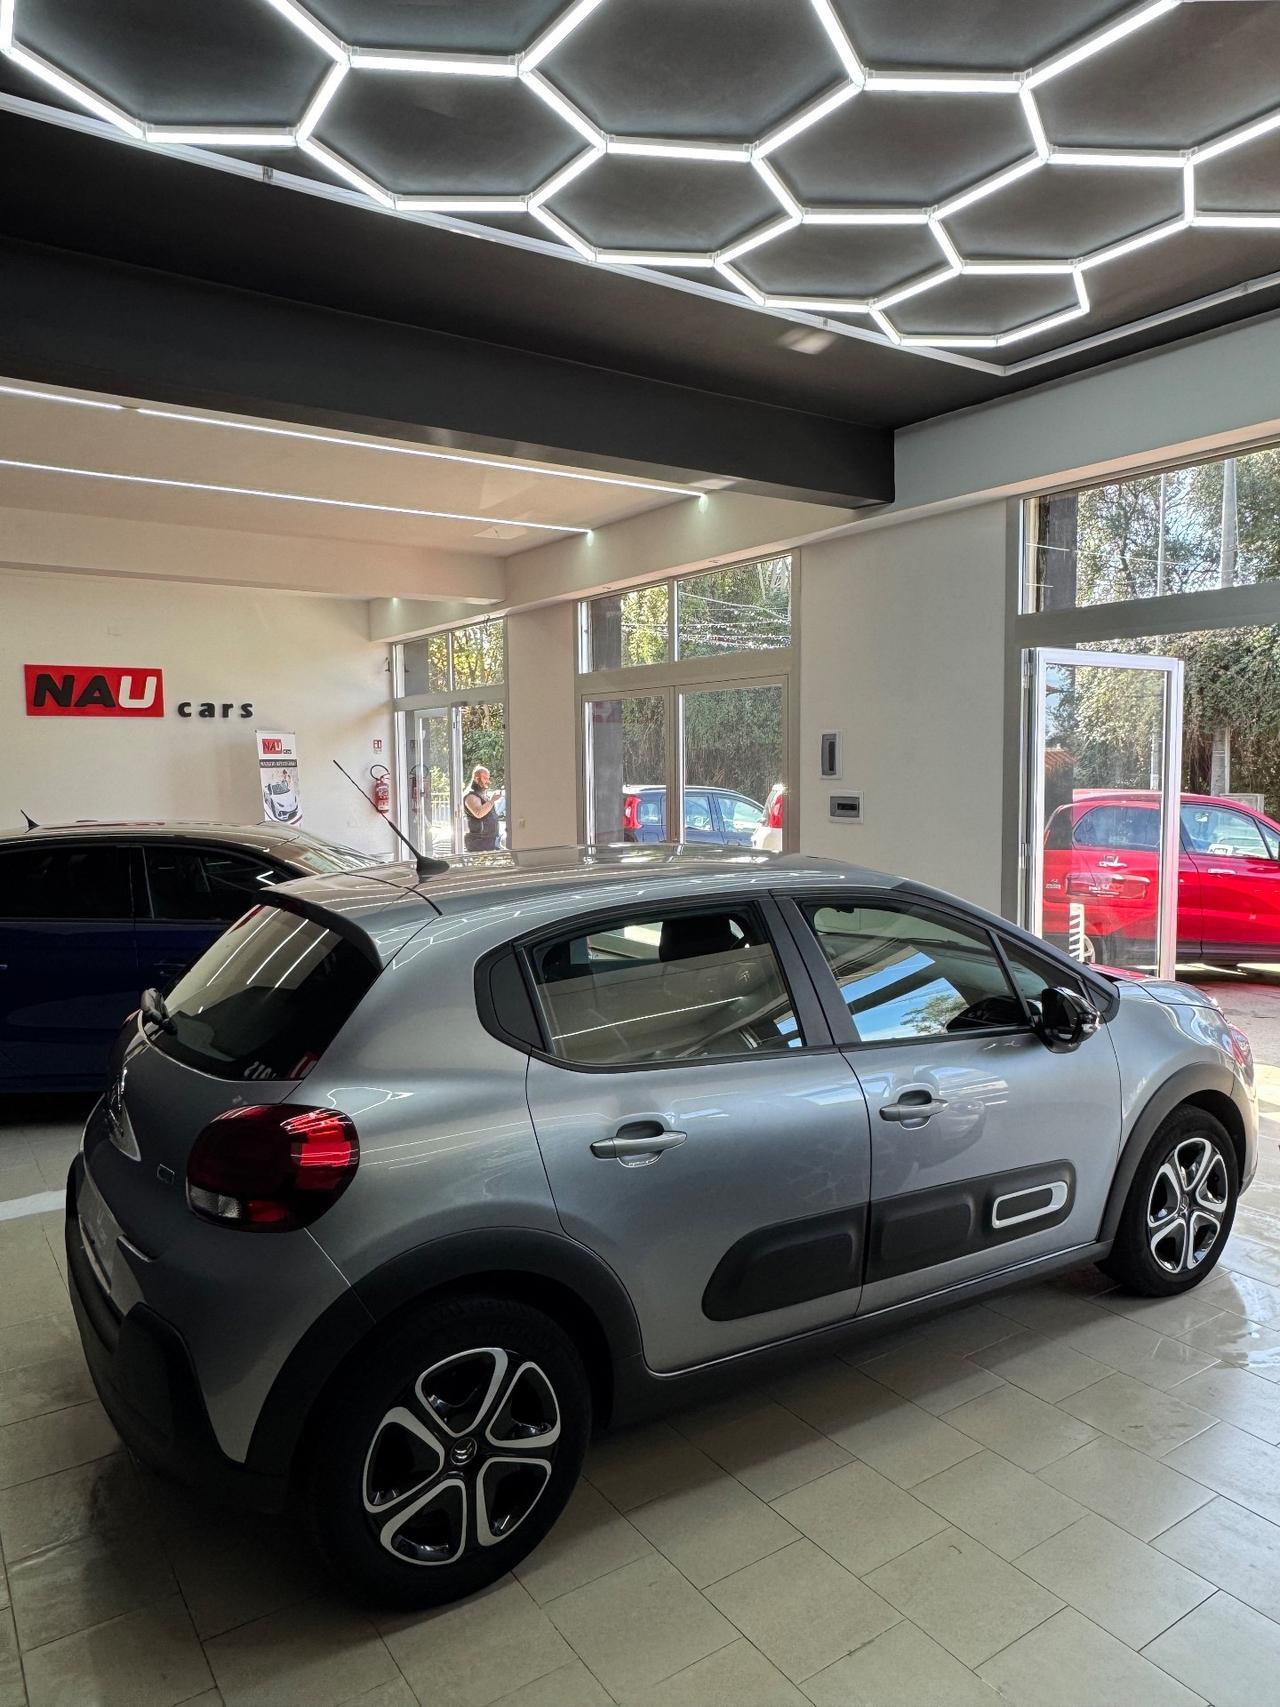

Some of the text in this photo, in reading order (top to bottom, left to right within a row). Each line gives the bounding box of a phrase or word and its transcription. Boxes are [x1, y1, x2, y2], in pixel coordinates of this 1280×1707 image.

[33, 674, 254, 719] NAU cars
[263, 741, 282, 752] NAU
